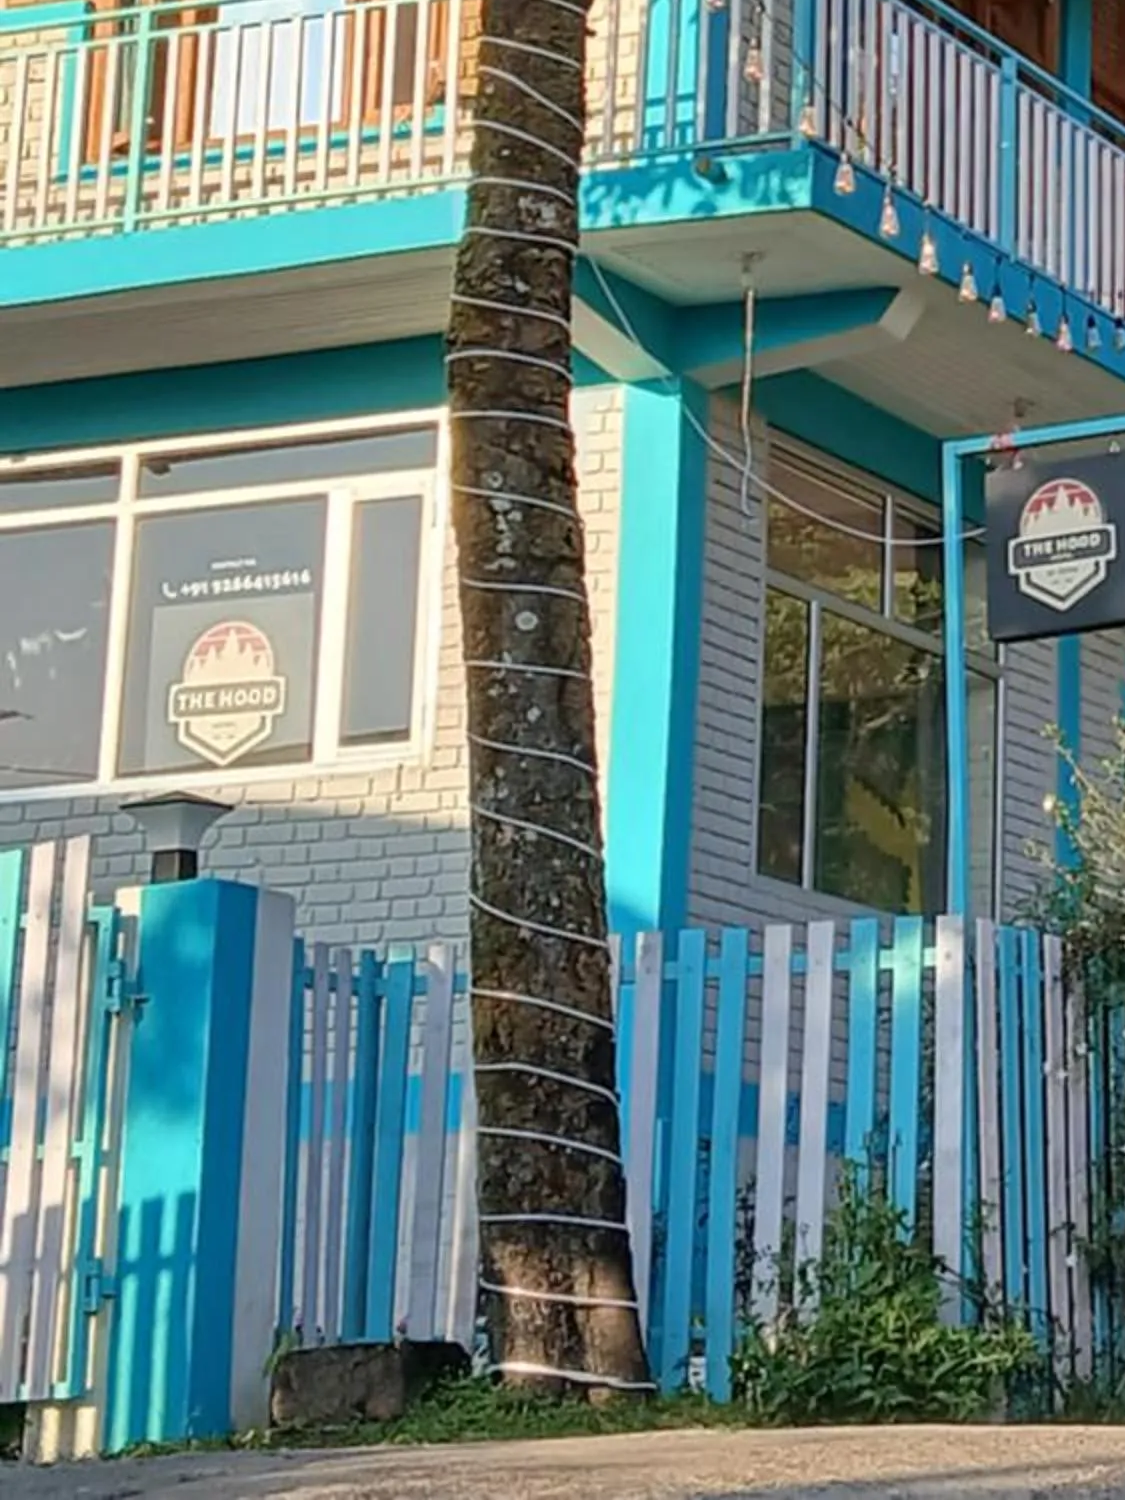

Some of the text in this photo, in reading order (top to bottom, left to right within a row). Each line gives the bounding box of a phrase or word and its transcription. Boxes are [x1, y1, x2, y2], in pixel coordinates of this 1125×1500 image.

[1023, 541, 1052, 557] THE
[1056, 532, 1101, 551] HOOD
[177, 685, 277, 711] THE HOOD
